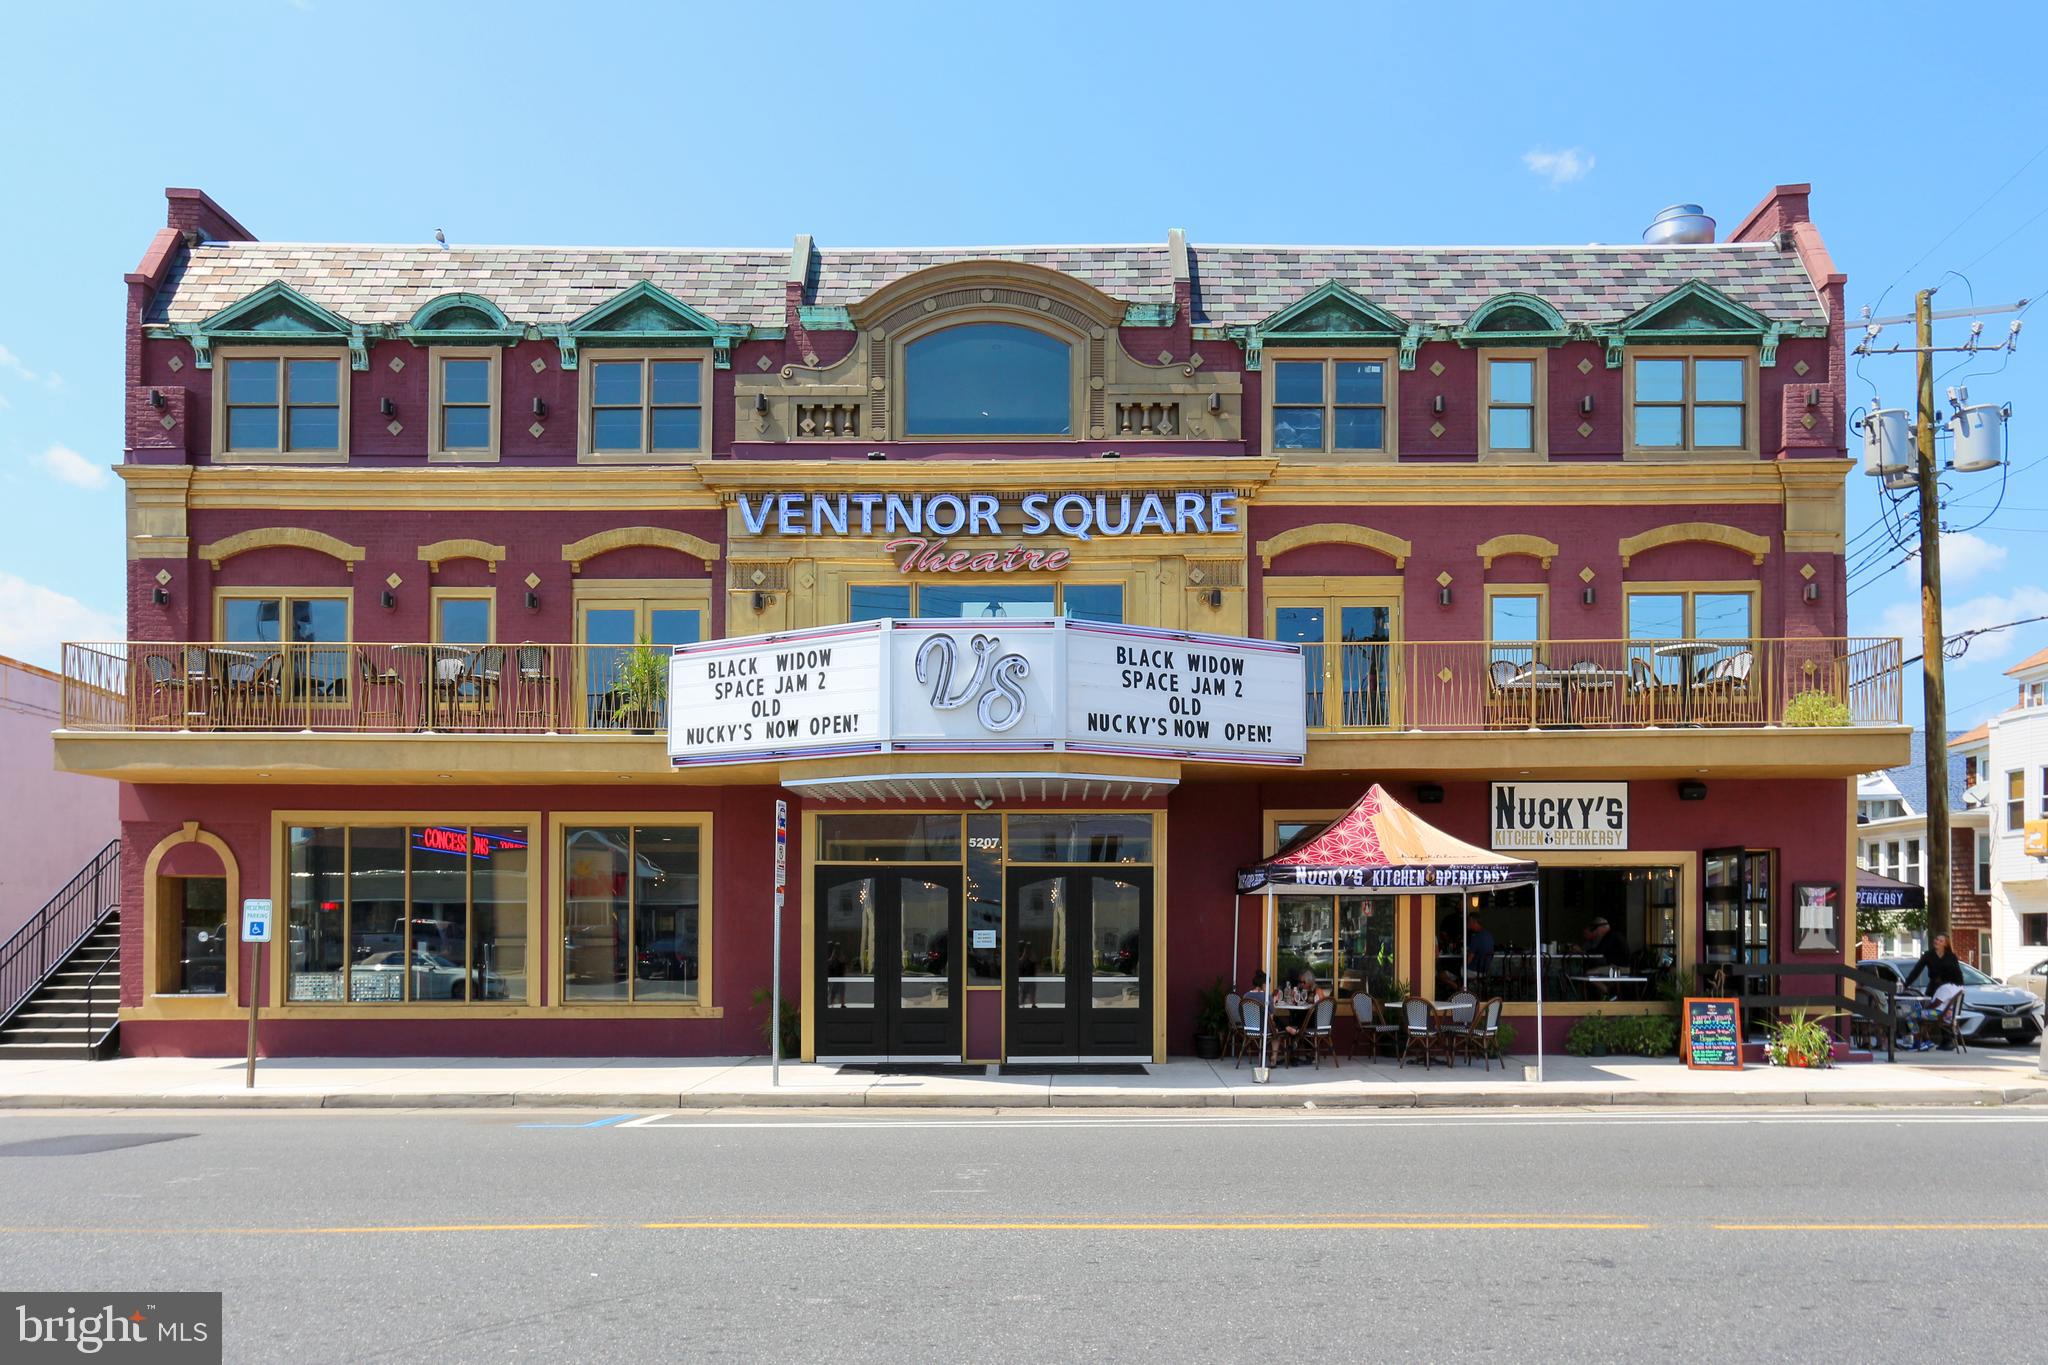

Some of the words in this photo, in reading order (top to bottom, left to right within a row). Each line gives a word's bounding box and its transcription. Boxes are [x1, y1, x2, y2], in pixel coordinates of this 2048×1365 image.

[736, 493, 1002, 536] VENTNOR
[1021, 491, 1240, 542] SQUARE
[884, 537, 1073, 573] Theatre
[707, 656, 758, 679] BLACK
[775, 648, 832, 672] WIDOW
[1116, 646, 1174, 670] BLACK
[1187, 653, 1245, 677] WIDOW
[714, 679, 764, 700] SPACE
[776, 673, 808, 694] JAM
[818, 671, 827, 691] 2
[1121, 669, 1180, 693] SPACE
[1191, 676, 1226, 698] JAM
[1234, 678, 1243, 698] 2
[751, 699, 781, 718] OLD
[1168, 695, 1201, 716] OLD
[686, 721, 752, 745] NUCKY'S
[765, 719, 800, 740] NOW
[810, 713, 860, 737] OPEN!
[1087, 712, 1168, 737] NUCKY'S
[1174, 718, 1210, 740] NOW
[1224, 722, 1273, 743] OPEN!
[1496, 786, 1623, 829] NUCKY'S
[969, 837, 1000, 848] 5207
[1495, 830, 1543, 845] KITCHEN
[1373, 869, 1424, 887] KITCHEN
